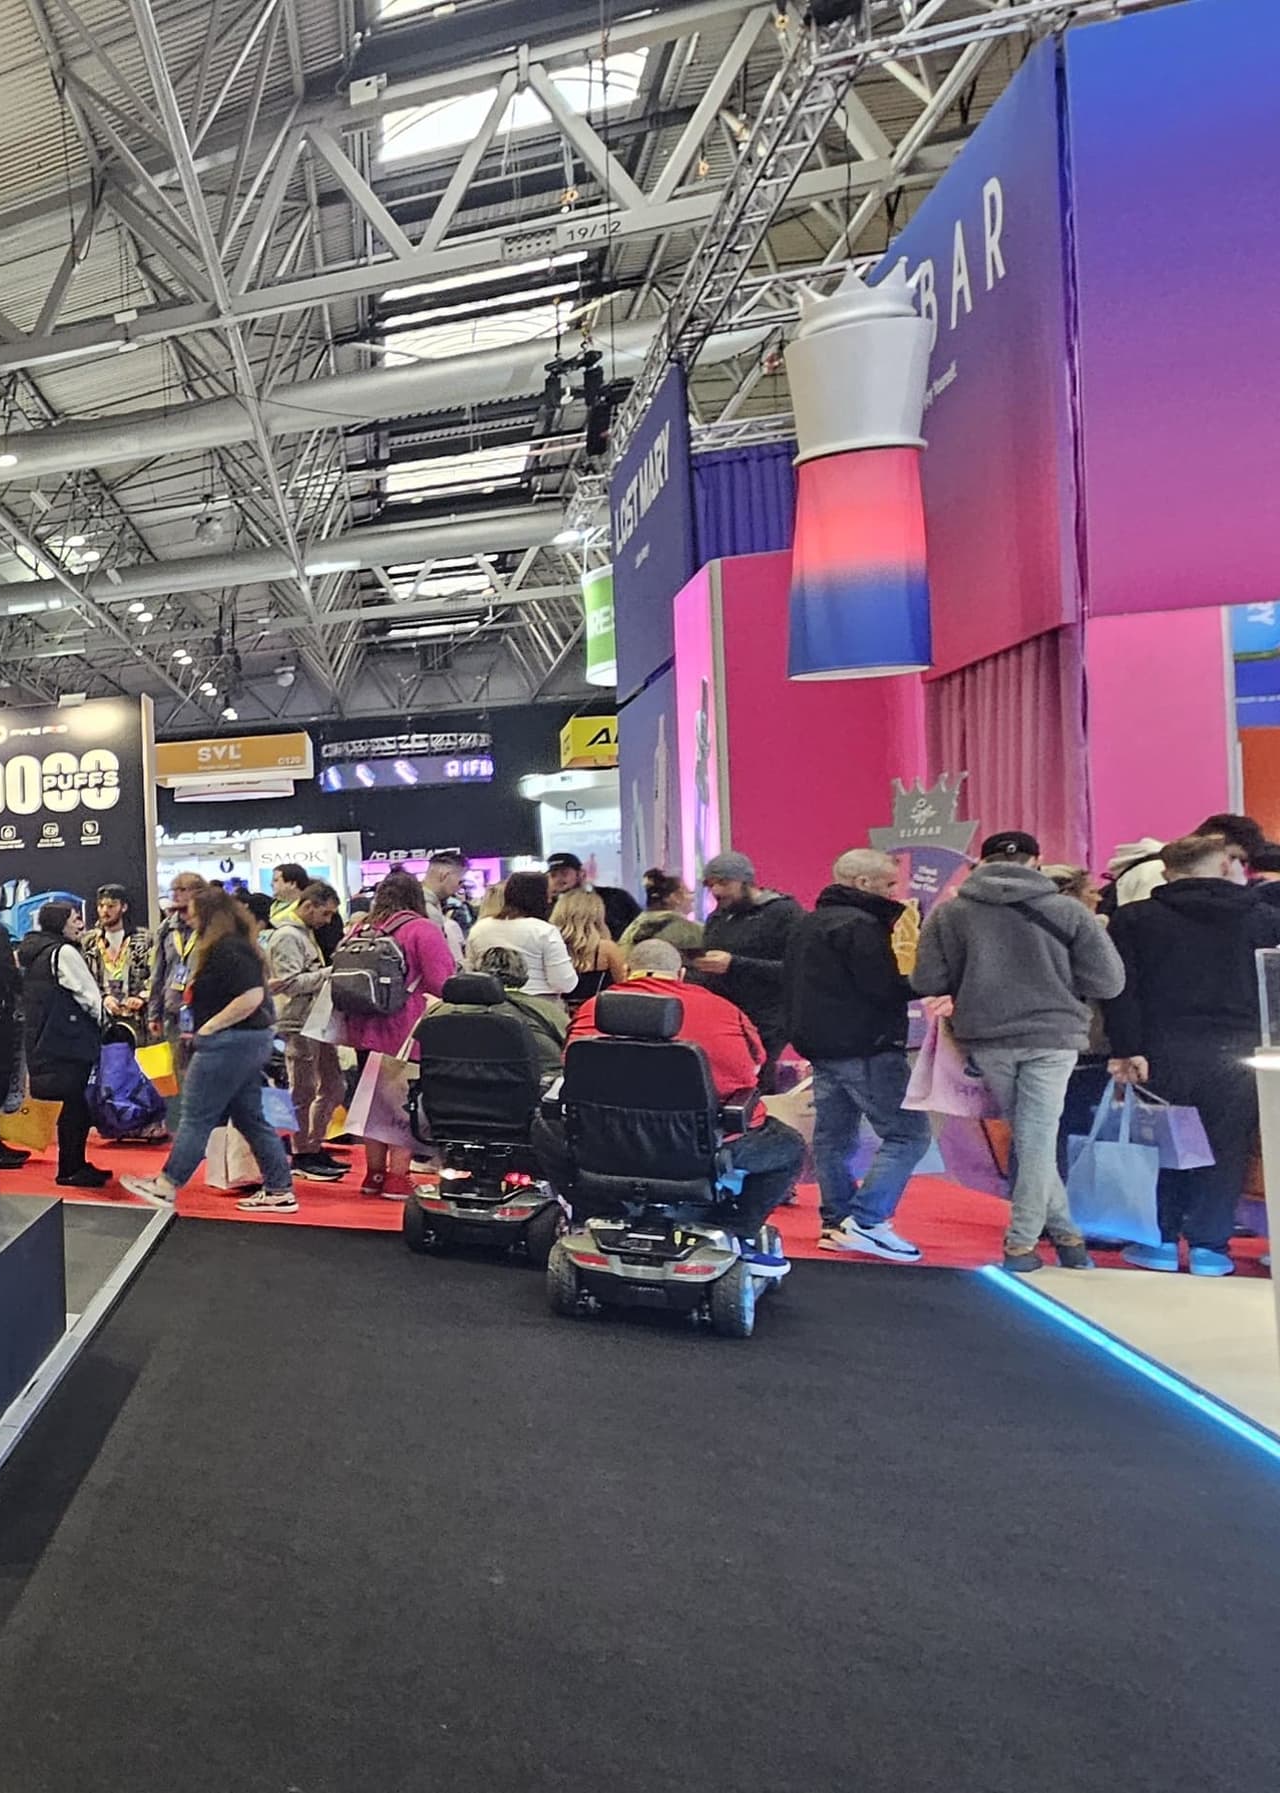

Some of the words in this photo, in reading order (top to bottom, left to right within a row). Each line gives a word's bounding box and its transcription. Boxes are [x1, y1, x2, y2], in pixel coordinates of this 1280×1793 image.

[567, 220, 622, 241] 19/12
[615, 474, 639, 555] LOST
[639, 419, 671, 518] MARY
[197, 744, 242, 763] SVL
[43, 771, 119, 791] PUFFS
[261, 851, 323, 865] SMOK
